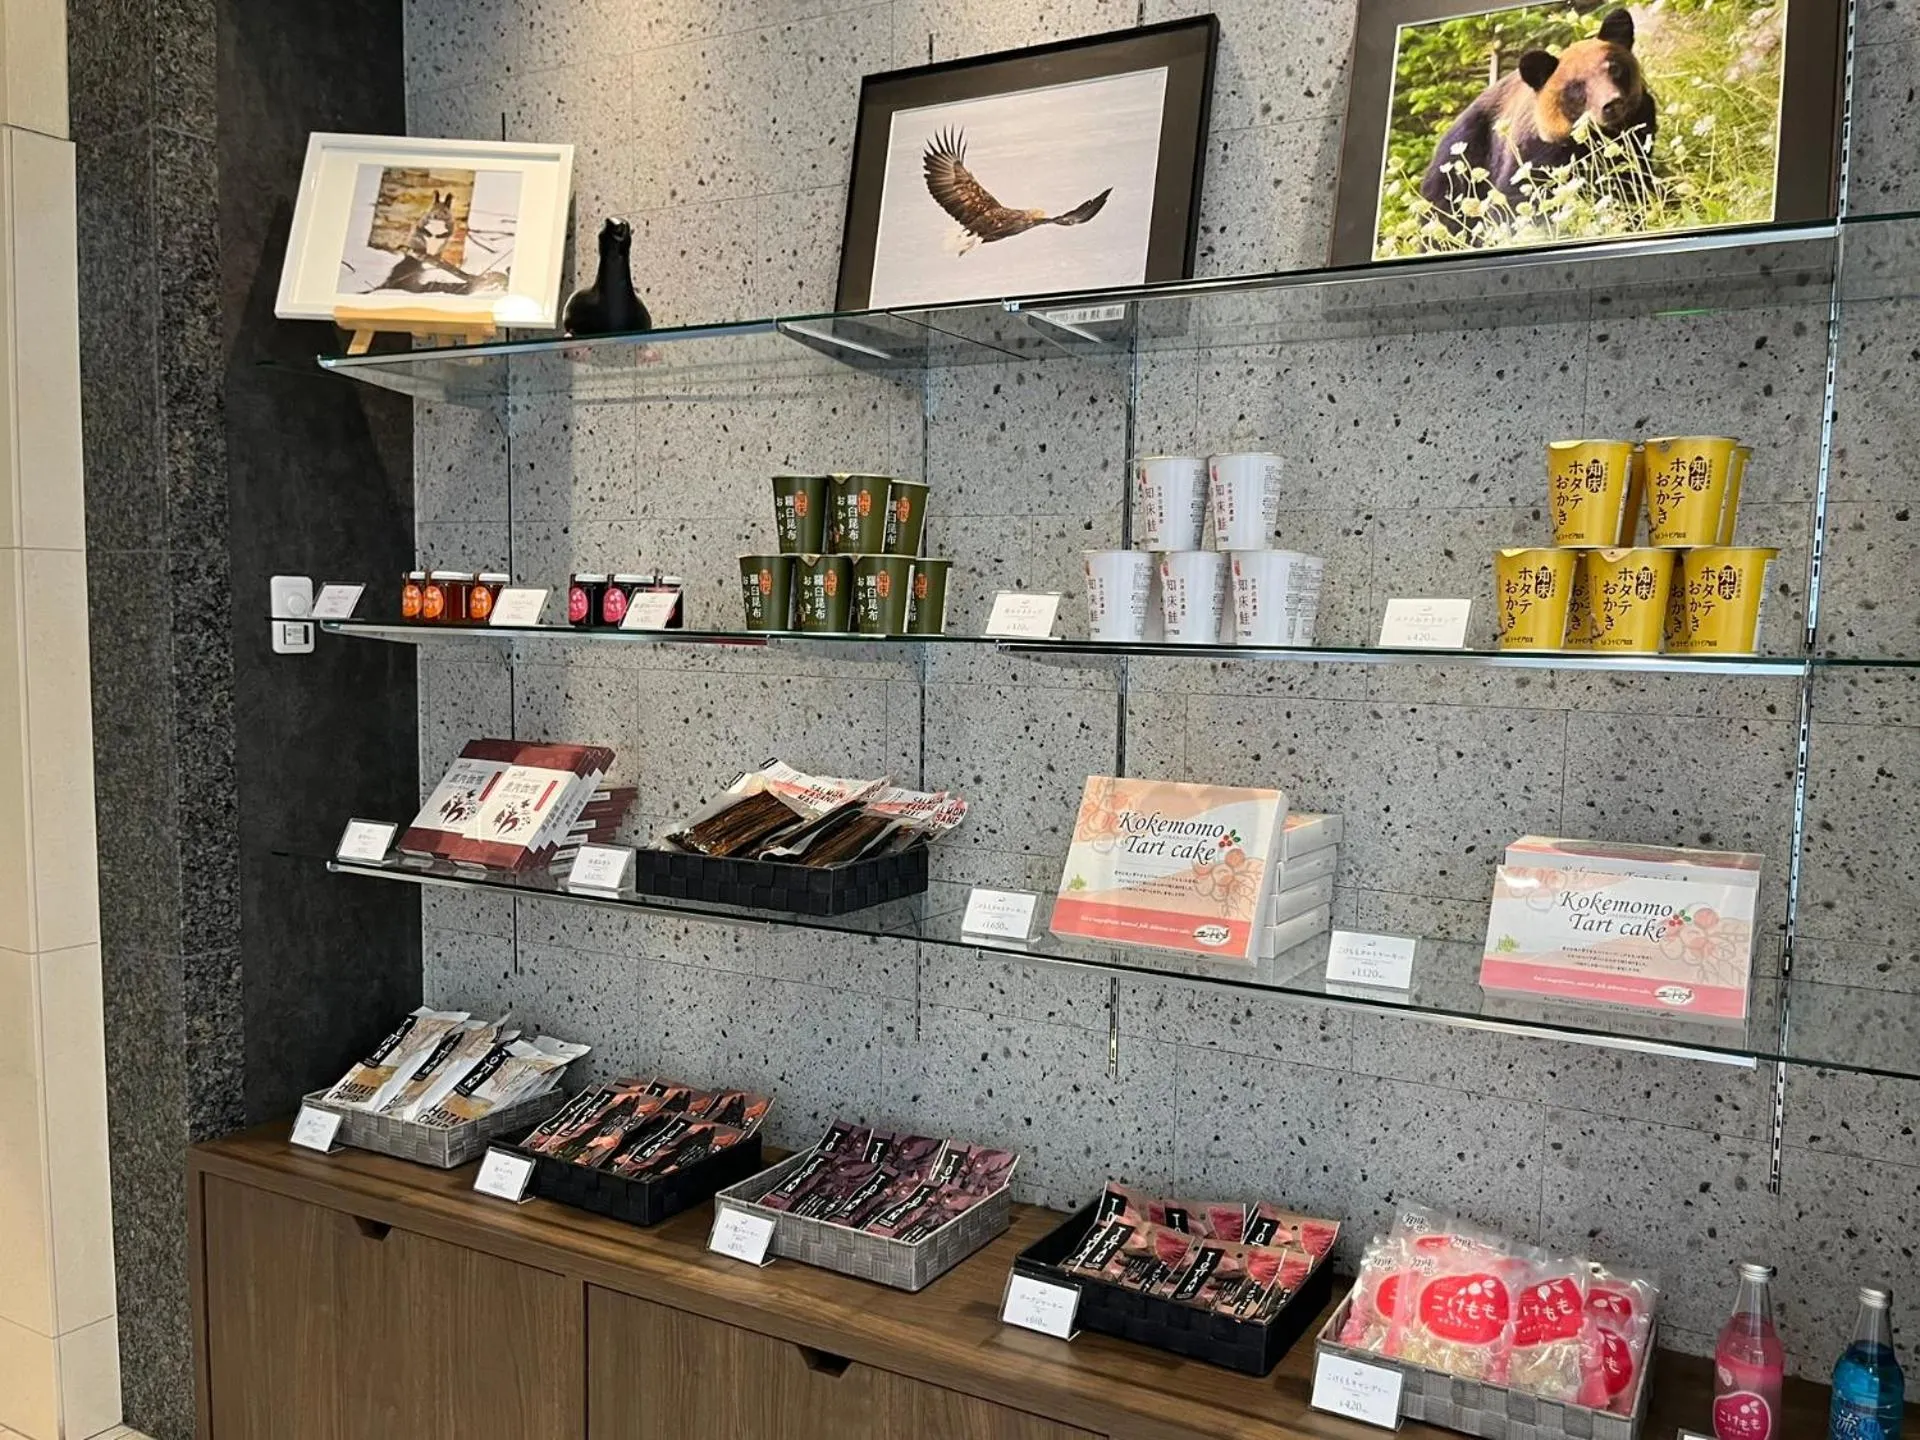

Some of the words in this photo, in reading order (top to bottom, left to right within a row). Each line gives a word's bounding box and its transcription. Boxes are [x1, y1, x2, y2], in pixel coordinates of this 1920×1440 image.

[1569, 460, 1583, 511] ホタテ
[1588, 463, 1602, 492] 知床
[1671, 457, 1687, 509] ホタテ
[1690, 459, 1707, 490] 知床
[1556, 474, 1569, 526] おかき
[1656, 471, 1670, 525] おかき
[1519, 566, 1533, 615] ホタテ
[1537, 569, 1551, 598] 知床
[1618, 567, 1633, 616] ホタテ
[1638, 569, 1652, 599] 知床
[1701, 566, 1716, 617] ホタテ
[1719, 568, 1736, 599] 知床
[1505, 579, 1519, 629] おかき
[1603, 580, 1618, 631] おかき
[1689, 580, 1702, 632] おかき
[810, 784, 845, 801] SALMON
[1119, 811, 1225, 838] Kokemomo
[1124, 835, 1166, 857] Tart
[1172, 839, 1216, 865] cake
[1560, 890, 1673, 918] Kokemomo
[1569, 913, 1613, 933] Tart
[1620, 918, 1667, 943] cake
[1431, 1294, 1499, 1321] こけもも
[1719, 1409, 1762, 1432] こけもも
